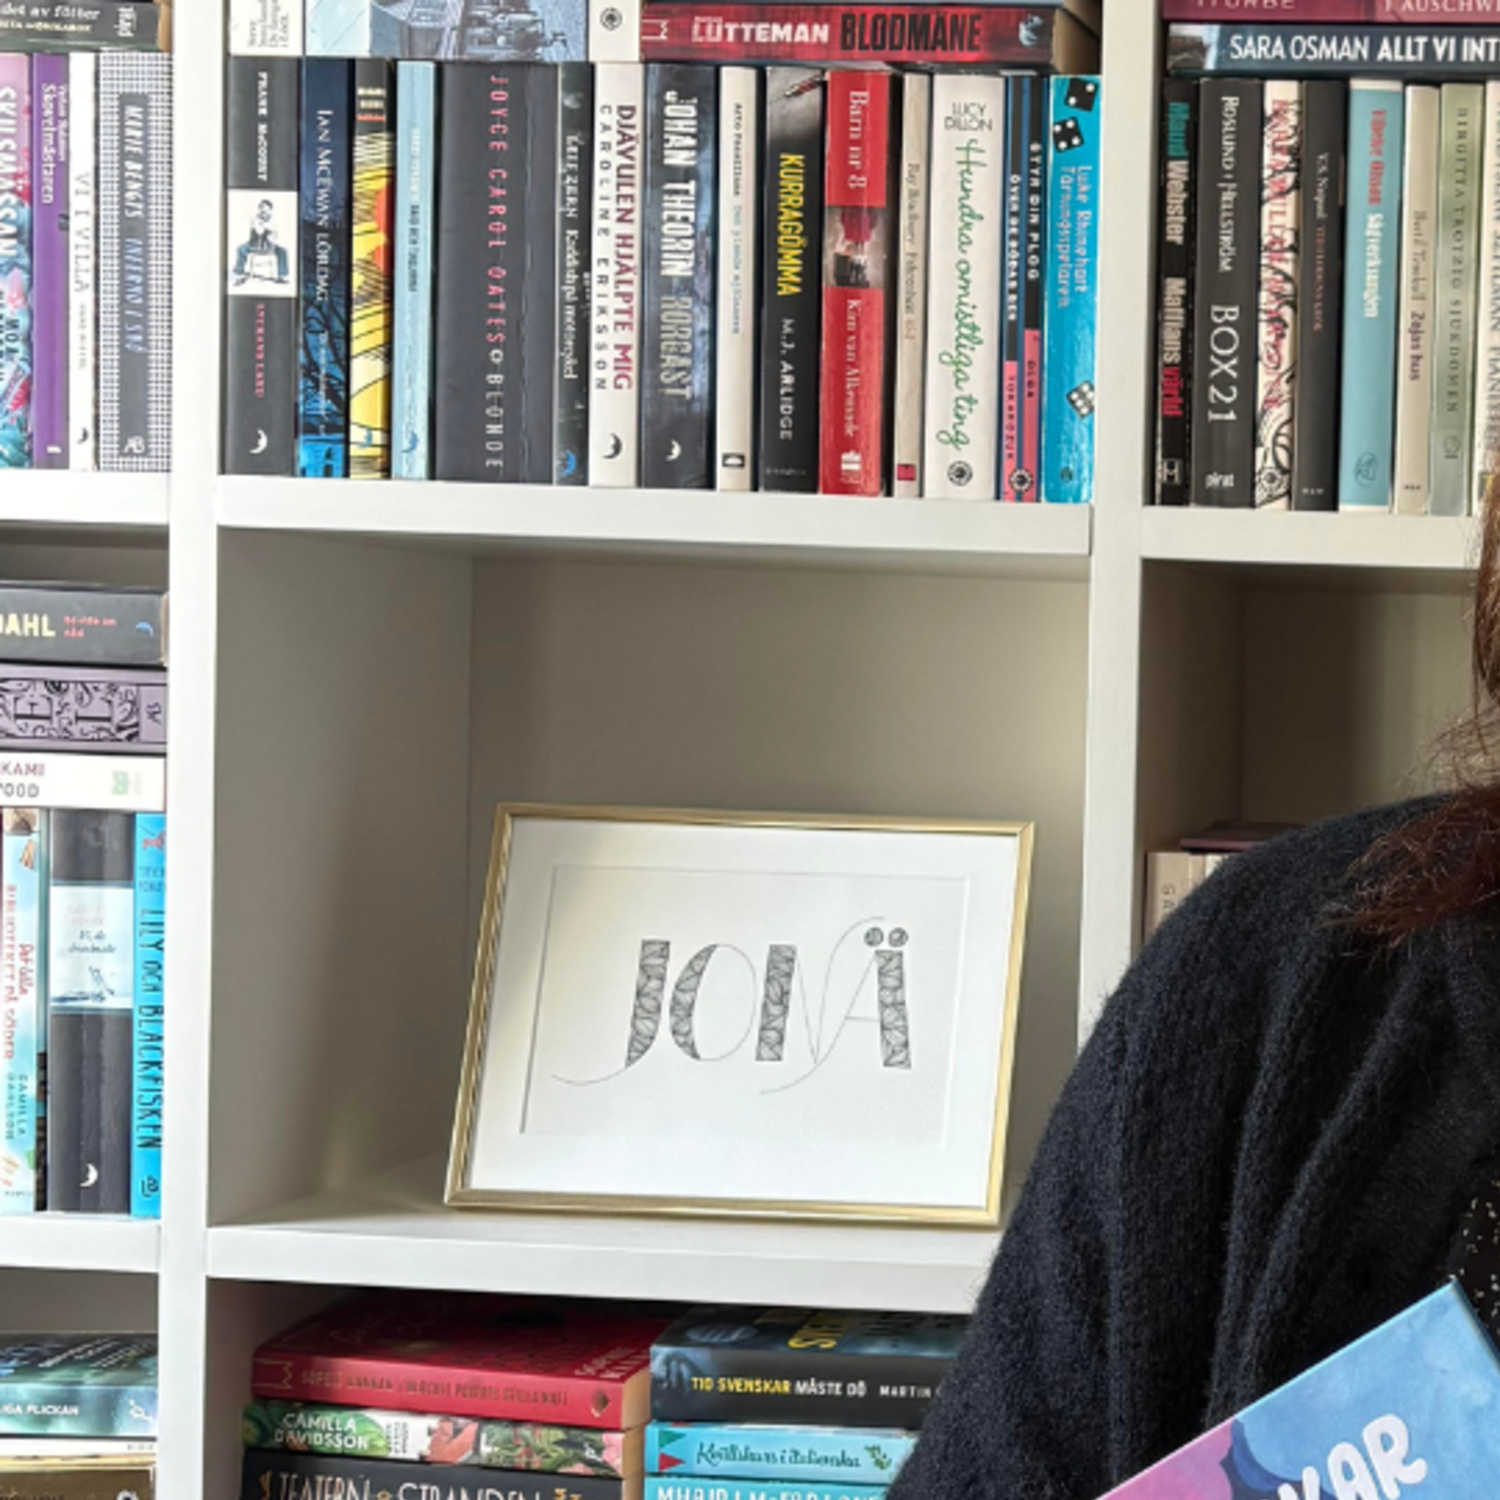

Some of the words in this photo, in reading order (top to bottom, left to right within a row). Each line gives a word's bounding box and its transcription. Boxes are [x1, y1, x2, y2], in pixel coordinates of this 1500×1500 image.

[1230, 34, 1286, 60] SARA
[1289, 35, 1368, 62] OSMAN
[1377, 36, 1427, 62] ALLT
[1433, 37, 1456, 62] VI
[489, 76, 509, 154] JOYCE
[662, 91, 698, 167] JOHAN
[1167, 102, 1190, 158] Maud
[597, 106, 613, 239] CAROLINE
[615, 106, 640, 225] DJÄVULEN
[954, 139, 989, 254] Hundra
[1074, 166, 1093, 204] Luke
[1165, 160, 1189, 246] Webster
[488, 171, 508, 250] CAROL
[660, 180, 698, 277] THEORIN
[776, 154, 808, 298] KURRAGÖMMA
[487, 268, 507, 345] OATES
[613, 234, 638, 334] HJÄLPTE
[1162, 278, 1185, 364] Maffians
[594, 259, 610, 392] ERIKSSON
[938, 260, 985, 391] omistliga
[1207, 306, 1239, 381] BOX
[612, 344, 634, 392] MIG
[778, 362, 796, 442] ARLIDGE
[1161, 366, 1182, 417] värld
[1206, 386, 1238, 424] 21
[484, 376, 505, 471] BLONDE
[936, 395, 979, 453] ting
[135, 1005, 164, 1150] BLACKFISKEN
[282, 1412, 365, 1434] CAMILLA
[717, 1377, 792, 1394] SVENSKAR
[794, 1377, 843, 1396] MÅSTE
